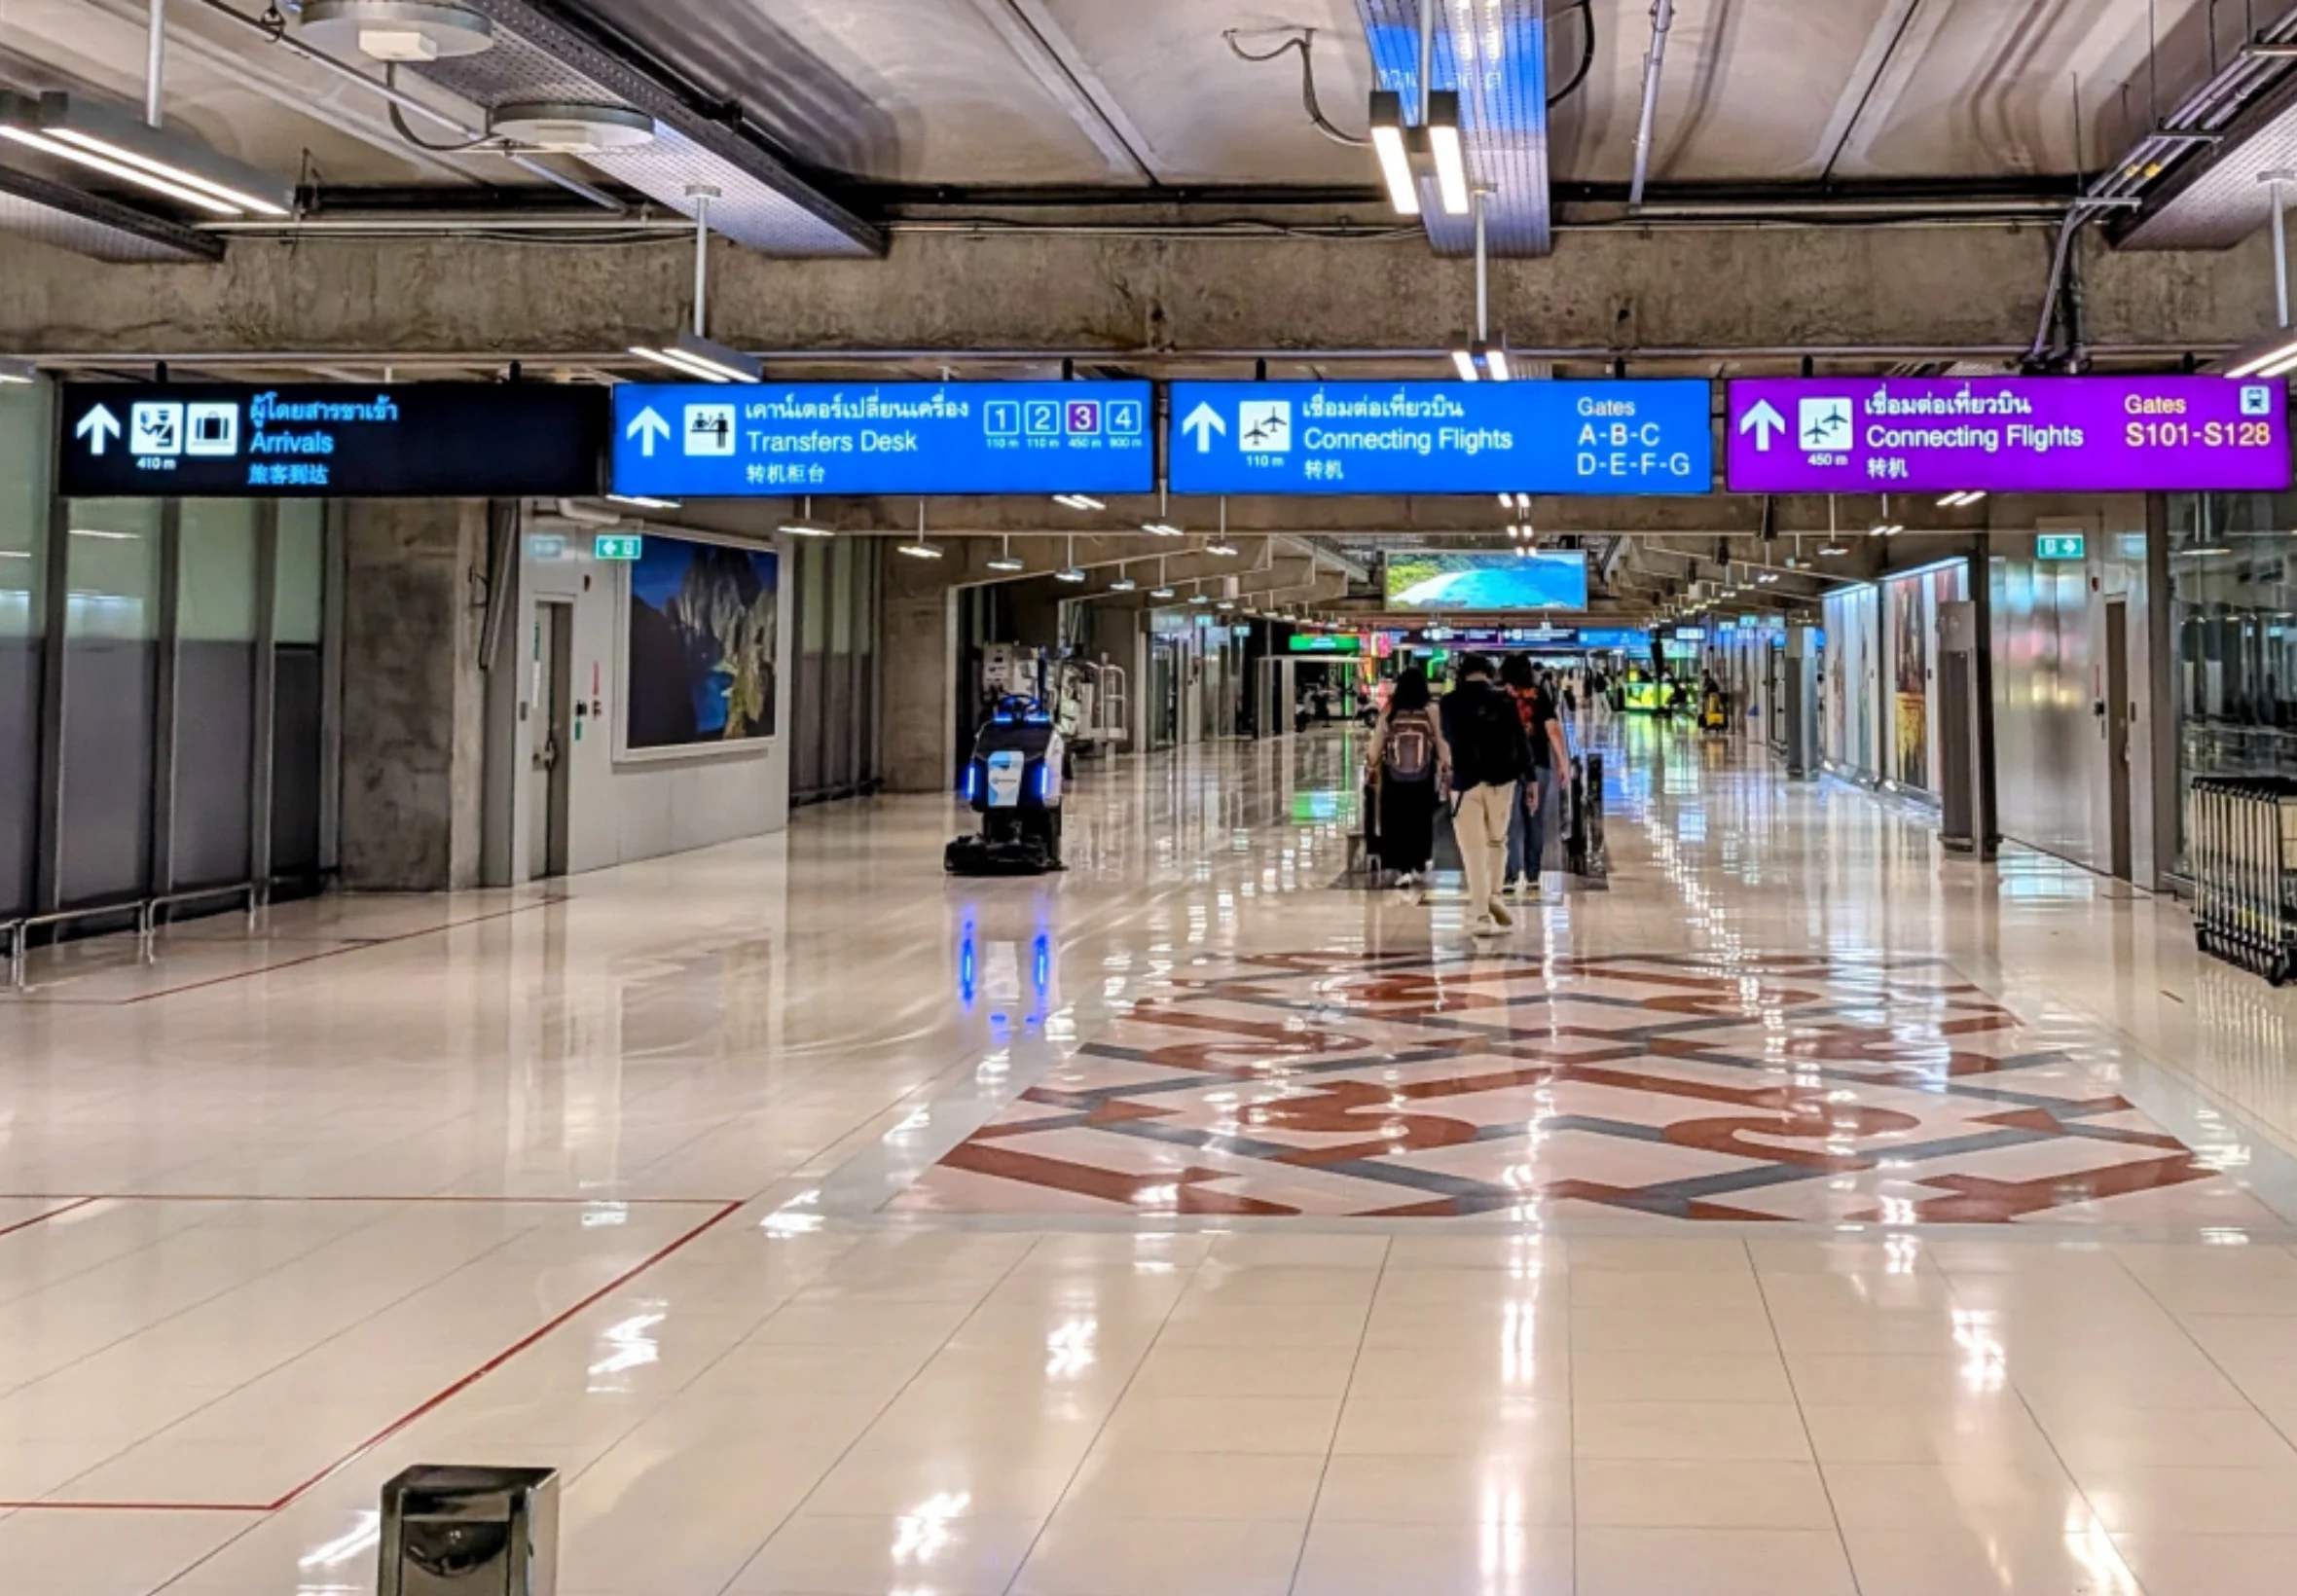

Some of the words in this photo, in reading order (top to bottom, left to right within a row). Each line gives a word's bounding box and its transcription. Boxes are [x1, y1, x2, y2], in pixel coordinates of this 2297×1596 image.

[249, 391, 398, 428] ผู้โดยสารขาเข้า
[745, 387, 969, 419] เคาน์เตอร์เปลี่ยนเครื่อง
[1302, 386, 1466, 417] เชื่อมต่อเที่ยวบิน
[1577, 396, 1636, 417] Gates
[1864, 382, 2032, 415] เชื่อมต่อเที่ยวบิน
[2124, 394, 2187, 415] Gates
[994, 407, 1006, 430] 1
[1034, 406, 1051, 430] 2
[1075, 405, 1092, 430] 3
[1114, 406, 1132, 430] 4
[249, 431, 334, 453] Arrivals
[746, 430, 853, 453] Transfers
[860, 429, 918, 453] Desk
[1303, 427, 1431, 454] Connecting
[1439, 427, 1513, 454] Flights
[1577, 422, 1660, 447] A-B-C
[1866, 424, 1998, 453] Connecting
[2006, 424, 2084, 453] Flights
[2125, 421, 2272, 448] S101-S128
[135, 457, 161, 470] 410
[163, 459, 176, 470] m
[1246, 455, 1268, 467] 110
[1271, 457, 1284, 467] m
[1304, 459, 1344, 480] 转机
[1577, 452, 1690, 476] D-E-F-G
[1807, 453, 1832, 466] 450
[1835, 455, 1848, 466] m
[1867, 457, 1909, 479] 转机
[248, 463, 329, 485] 旅客到达
[746, 463, 825, 484] 转机柜台
